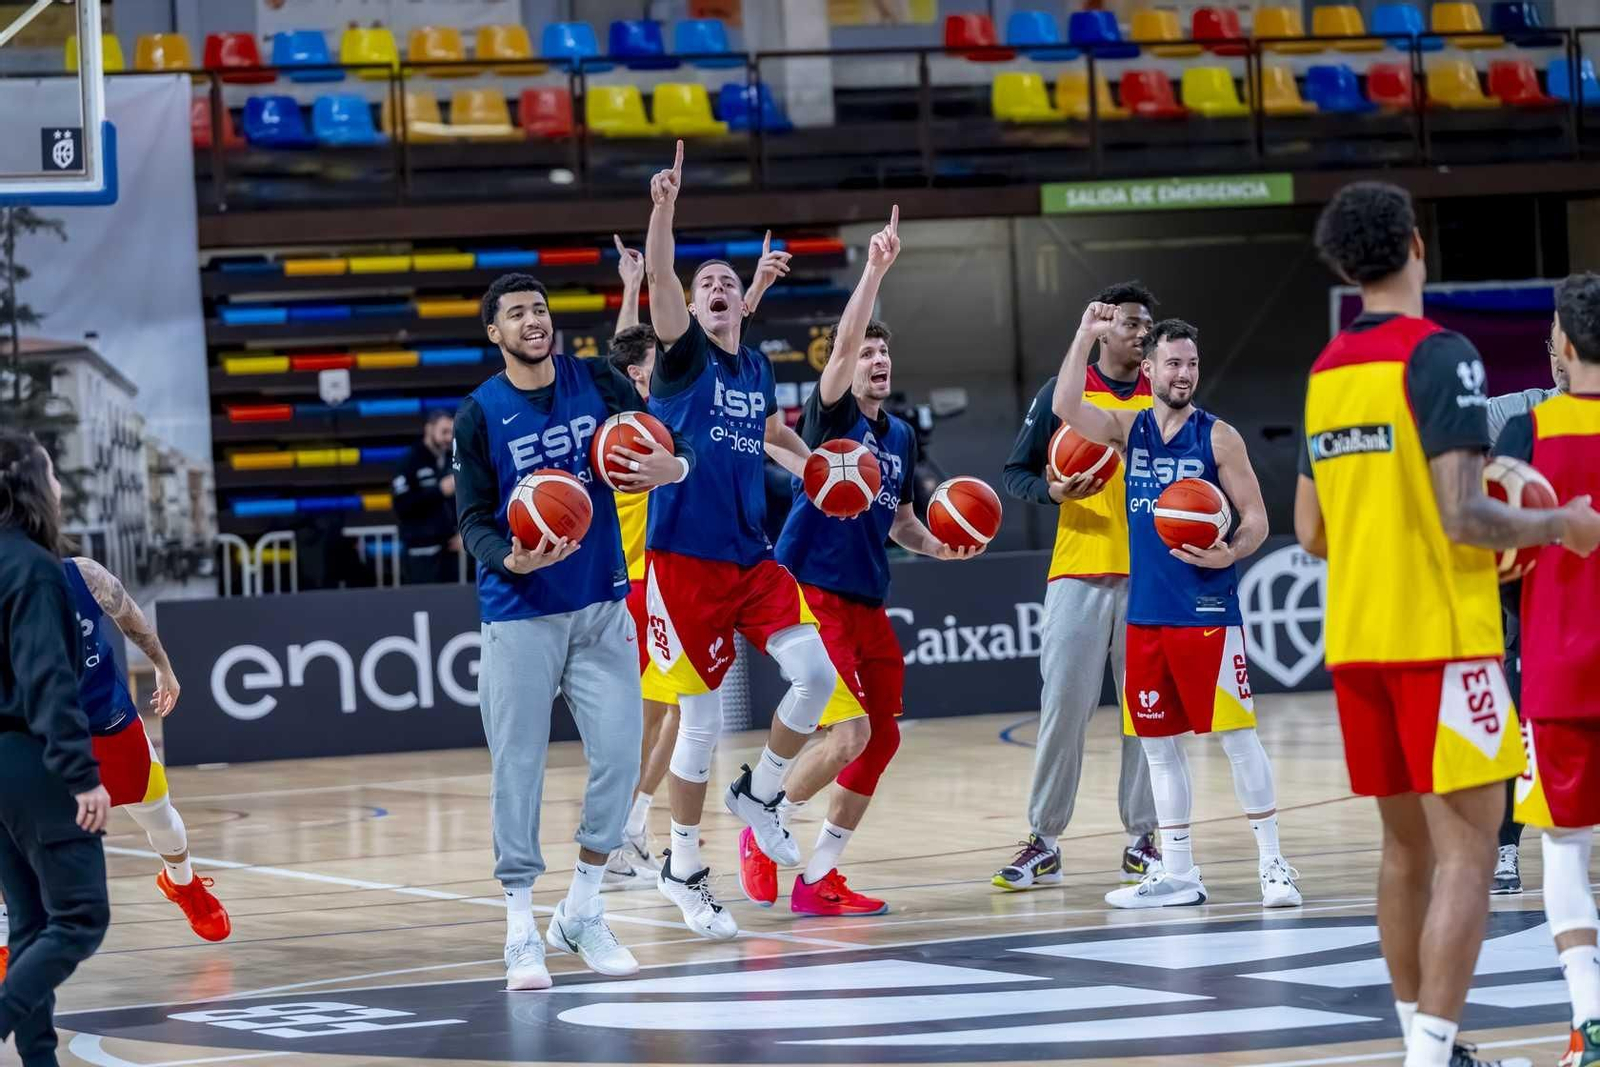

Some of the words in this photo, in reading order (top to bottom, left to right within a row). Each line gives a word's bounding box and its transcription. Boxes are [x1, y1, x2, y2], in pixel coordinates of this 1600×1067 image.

[1066, 188, 1128, 207] SALIDA
[1131, 186, 1153, 204] DE
[1157, 181, 1270, 202] EMERGENCIA
[507, 415, 597, 471] ESP
[1318, 427, 1389, 458] CaixaBank
[1130, 448, 1205, 484] ESP
[649, 615, 671, 661] ESP
[1232, 654, 1251, 700] ESP
[1462, 668, 1500, 734] ESP
